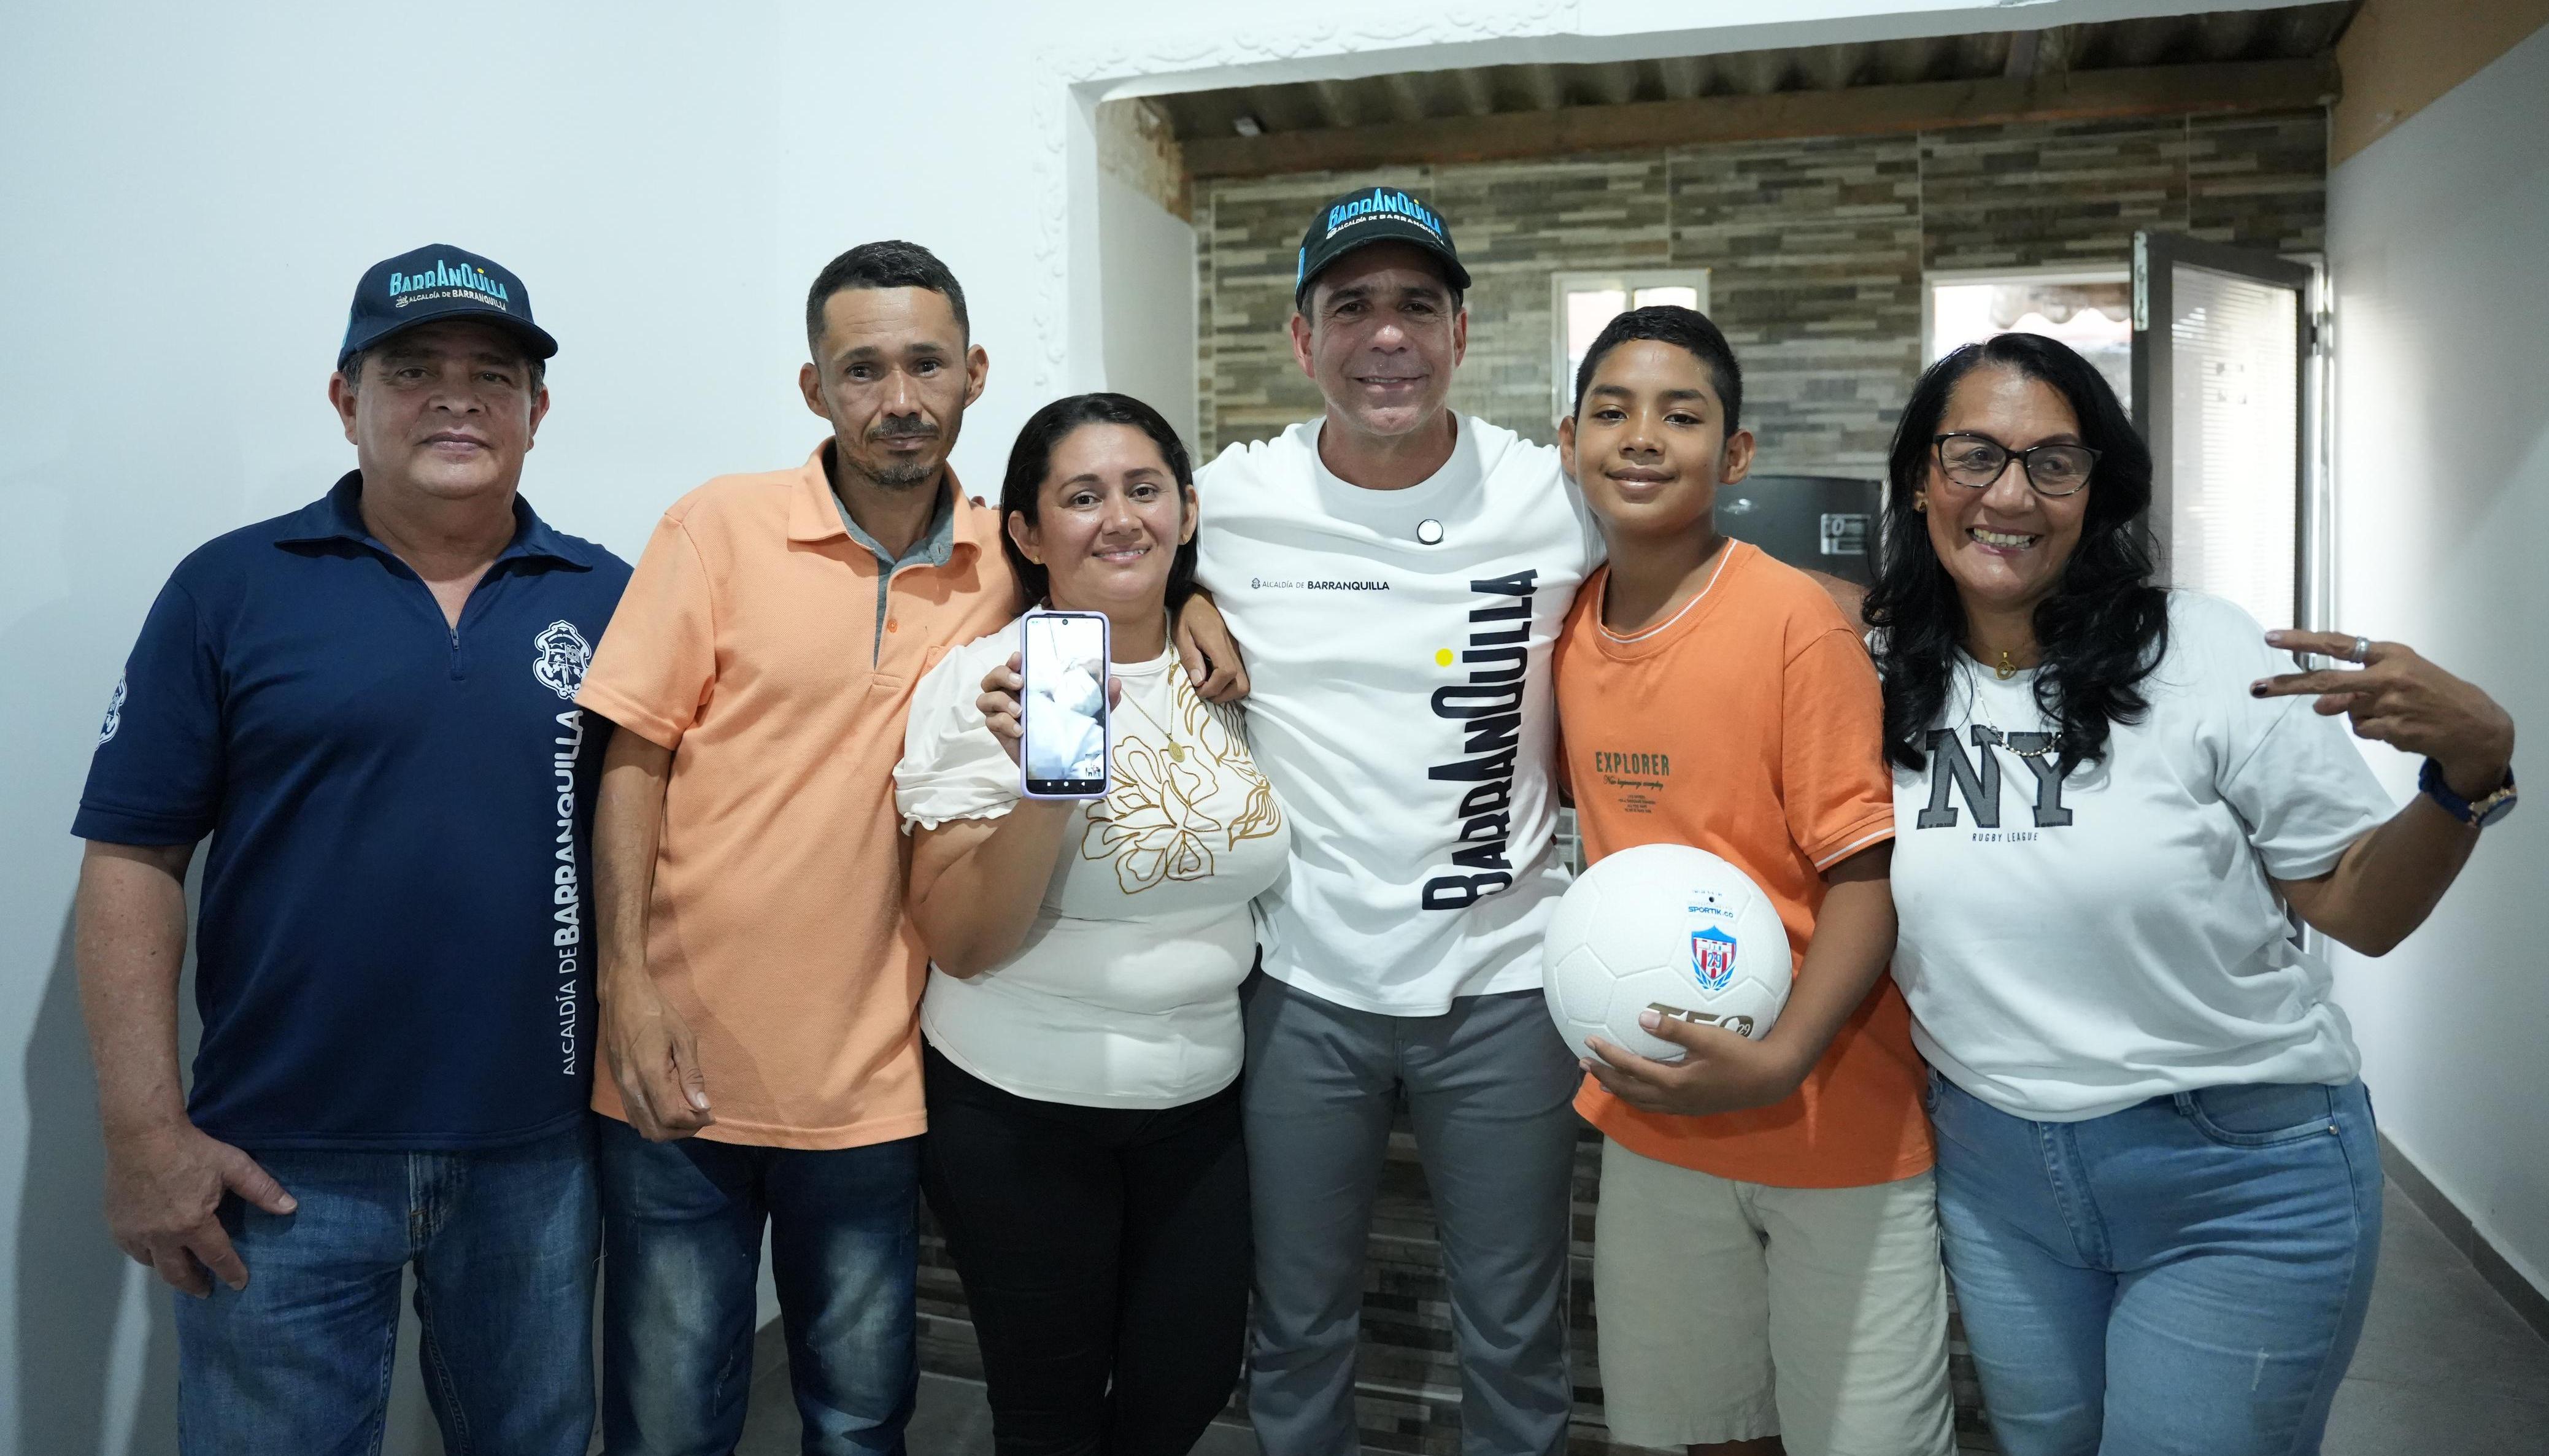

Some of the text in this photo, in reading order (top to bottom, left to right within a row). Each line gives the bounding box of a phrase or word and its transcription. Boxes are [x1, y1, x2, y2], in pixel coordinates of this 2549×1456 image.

[1335, 216, 1367, 233] ALCALDÍA
[1379, 214, 1445, 246] BARRANQUILLA
[409, 291, 439, 302] ALCALDÍA
[452, 289, 507, 312] BARRANQUILLA
[1308, 581, 1390, 591] BARRANQUILLA
[1595, 752, 1669, 776] EXPLORER
[1916, 724, 2073, 830] NY
[1972, 832, 2038, 842] RUGBY LEAGUE
[554, 709, 584, 1075] ALCALDÍA DE BARRANQUILLA
[1708, 952, 1721, 968] 29
[1738, 1023, 1751, 1035] 29
